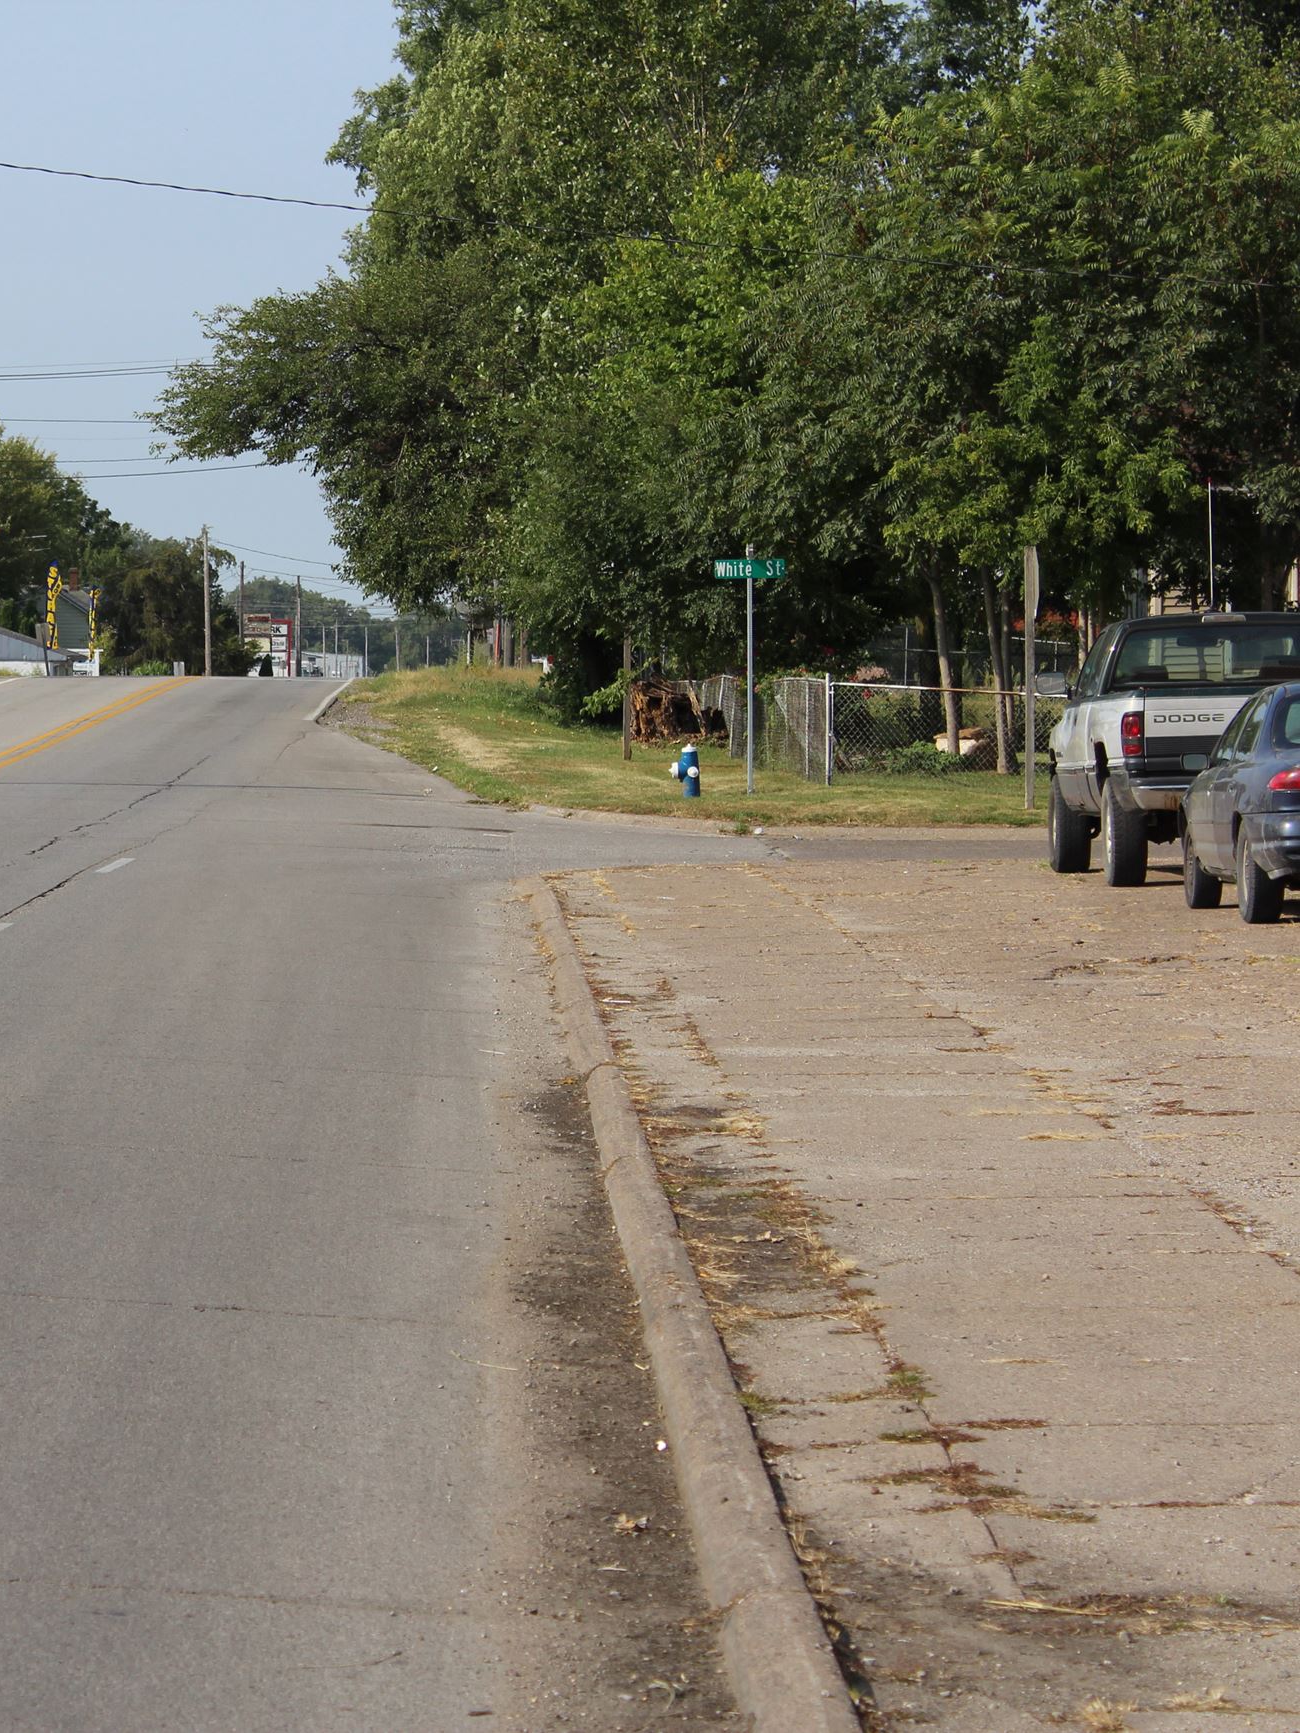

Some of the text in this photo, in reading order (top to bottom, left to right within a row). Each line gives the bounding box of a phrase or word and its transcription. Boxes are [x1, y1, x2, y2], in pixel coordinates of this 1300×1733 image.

[716, 561, 781, 577] White St
[1153, 713, 1225, 724] DODGE
